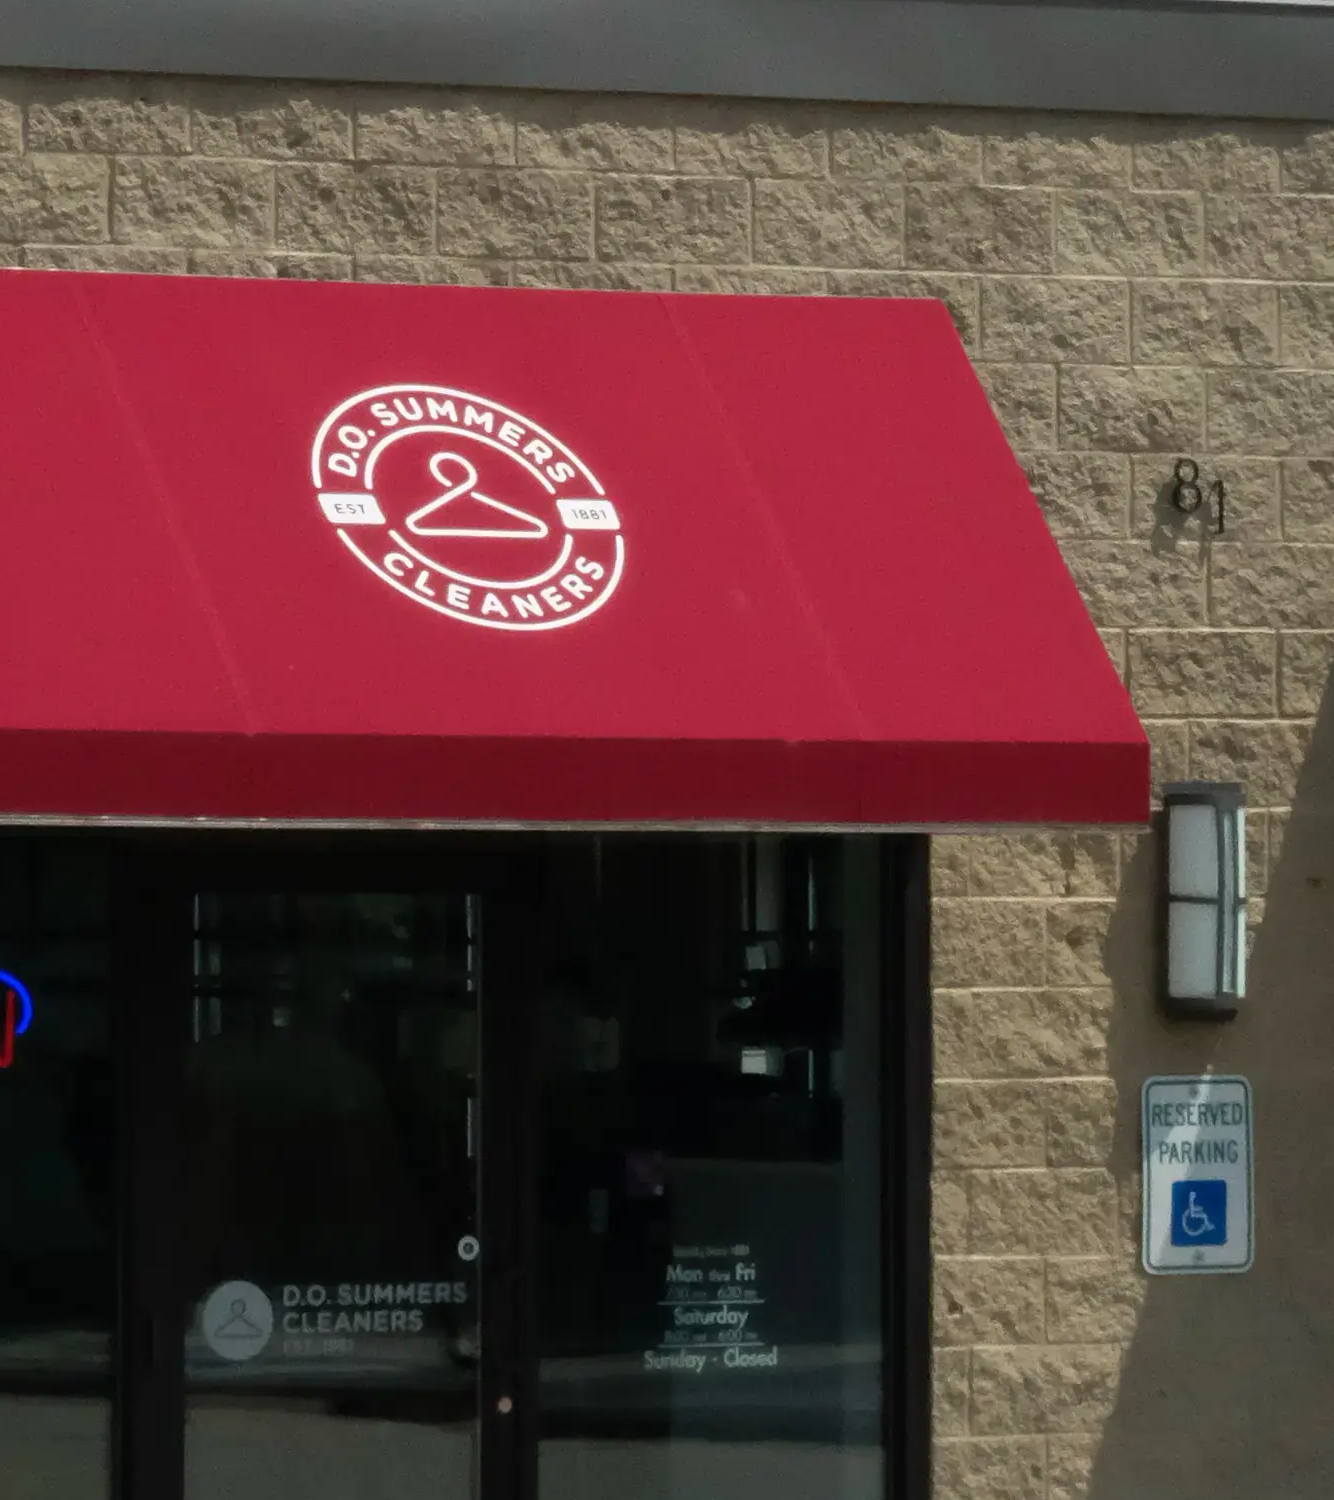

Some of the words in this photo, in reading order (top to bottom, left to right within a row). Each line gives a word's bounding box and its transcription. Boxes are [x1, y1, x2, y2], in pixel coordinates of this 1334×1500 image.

[327, 425, 376, 478] D.O.
[370, 397, 576, 484] SUMMERS
[334, 502, 366, 515] EST
[570, 508, 608, 521] 1881
[382, 551, 605, 619] CLEANERS
[1151, 1102, 1243, 1127] RESERVED
[1158, 1140, 1239, 1165] PARKING
[666, 1264, 704, 1282] Mon
[735, 1262, 756, 1281] Fri
[282, 1284, 331, 1307] D.O.
[337, 1281, 468, 1306] SUMMERS
[282, 1309, 424, 1333] CLEANERS
[674, 1304, 749, 1331] Saturday
[643, 1349, 707, 1373] Sunday
[723, 1345, 779, 1367] Closed
